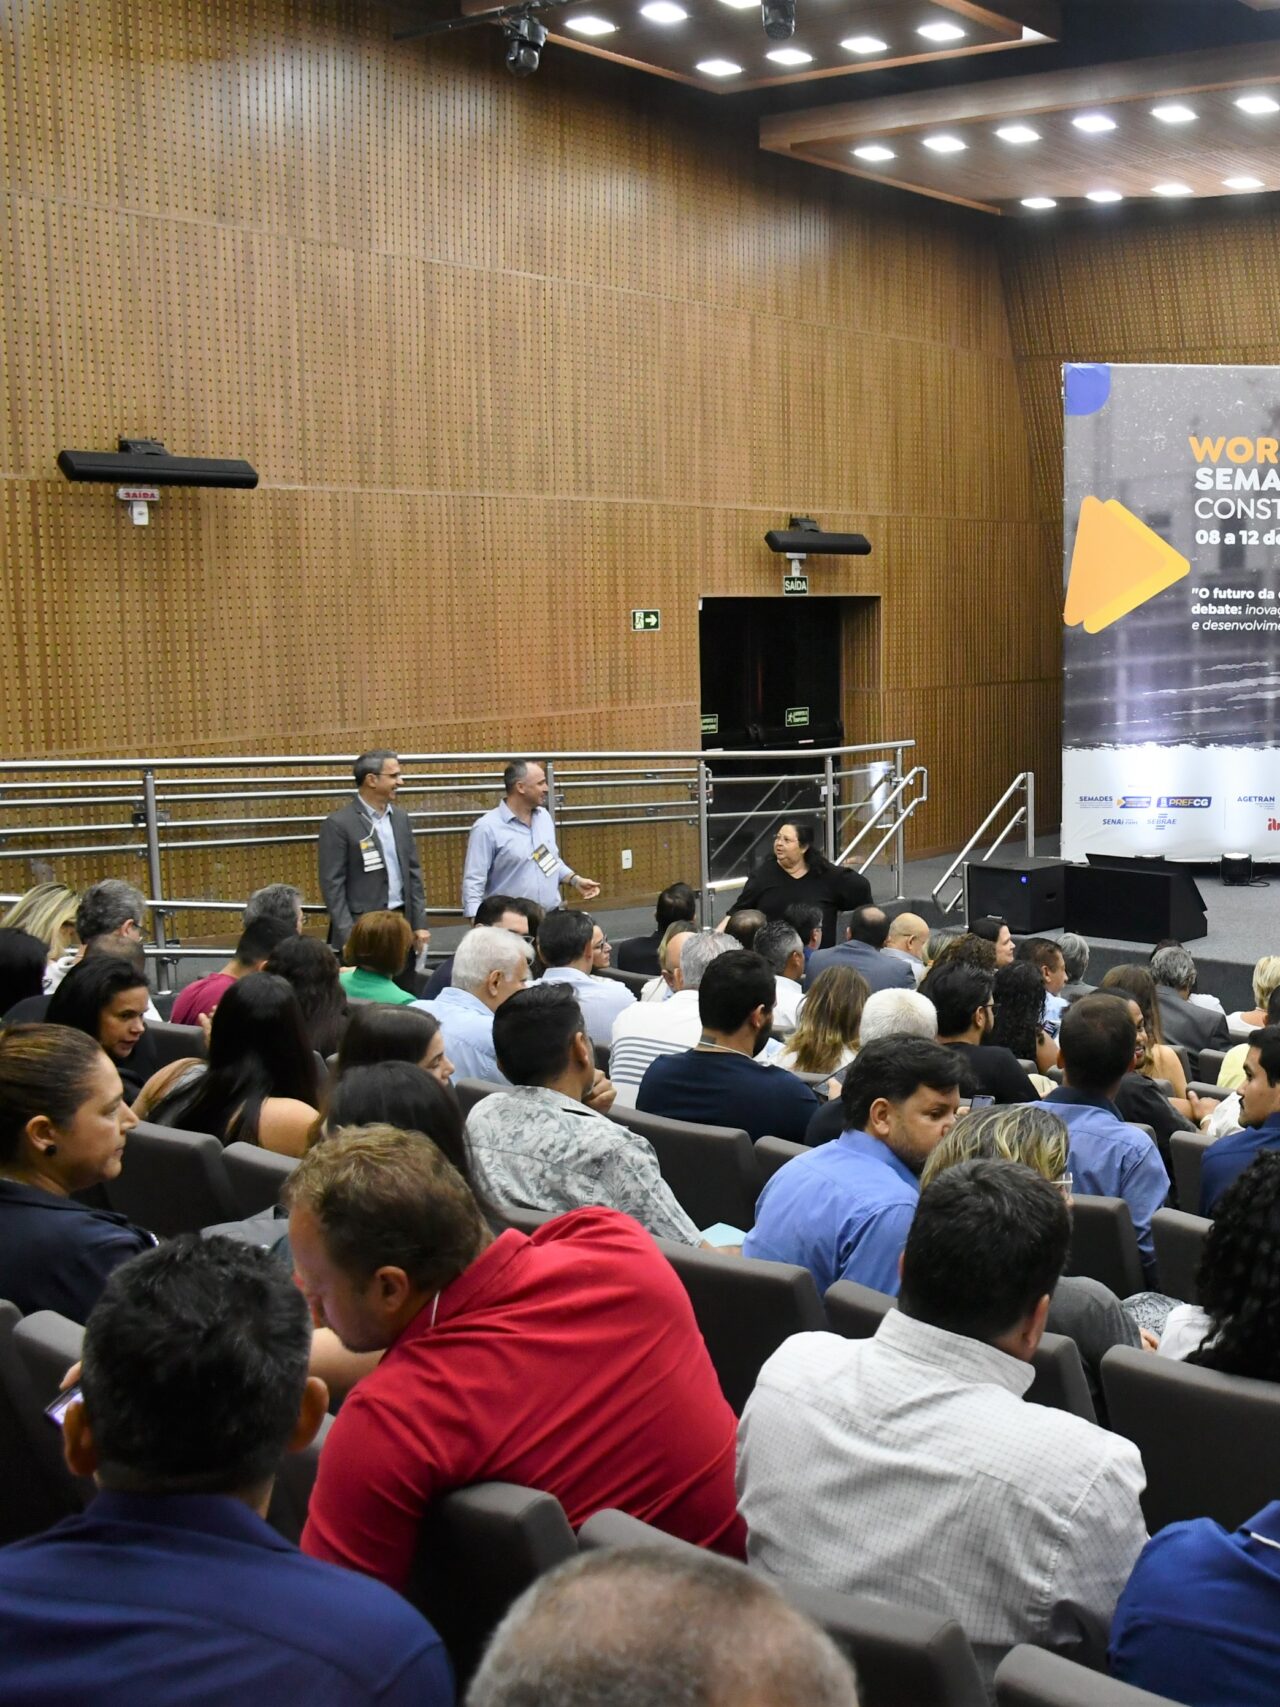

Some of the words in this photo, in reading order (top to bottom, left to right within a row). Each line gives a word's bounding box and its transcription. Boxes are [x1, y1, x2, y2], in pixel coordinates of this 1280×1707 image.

[1195, 530, 1220, 545] 08
[1224, 534, 1236, 545] a
[1239, 530, 1260, 545] 12
[1192, 588, 1210, 600] "O
[1213, 588, 1254, 600] futuro
[1258, 589, 1275, 601] da
[1191, 603, 1242, 615] debate:
[1191, 621, 1200, 631] e
[1237, 795, 1275, 803] AGETRAN
